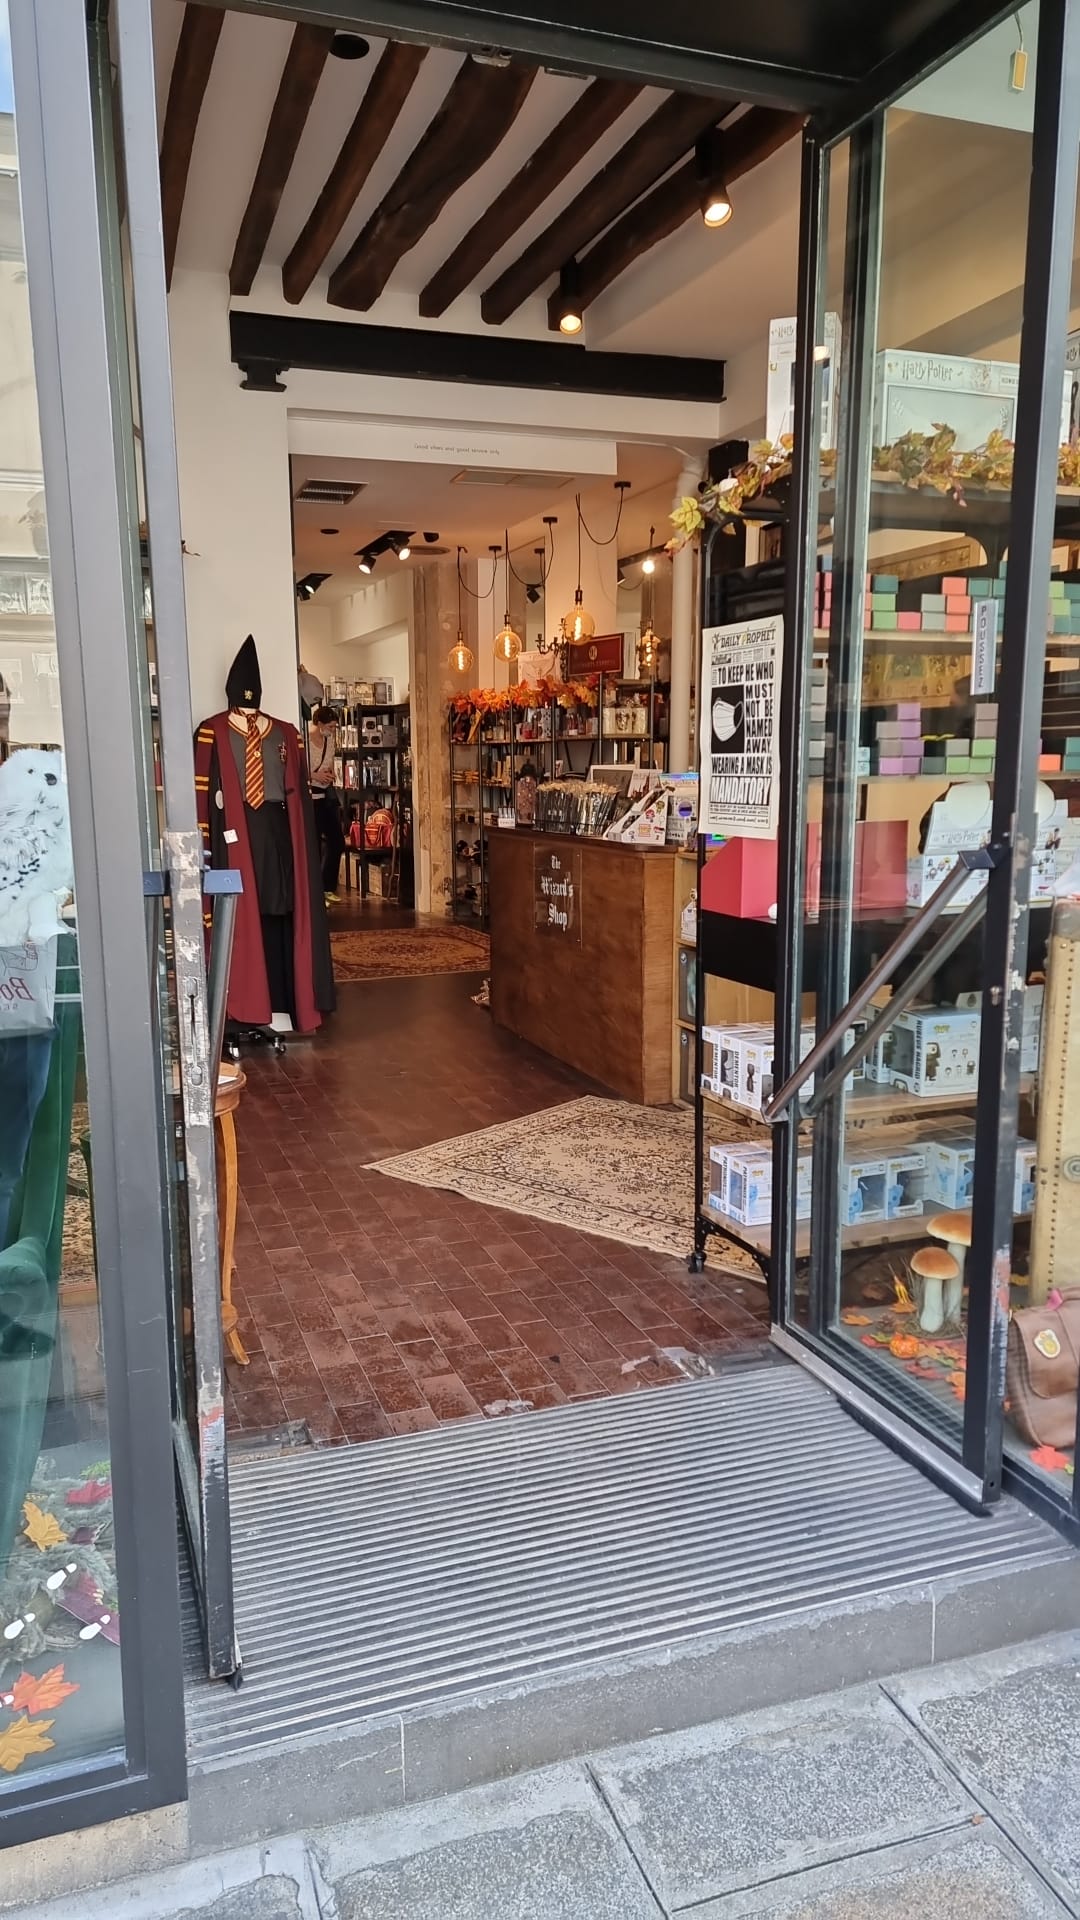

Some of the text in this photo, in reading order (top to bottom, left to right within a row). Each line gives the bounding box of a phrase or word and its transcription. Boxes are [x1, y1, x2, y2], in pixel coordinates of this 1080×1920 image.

[902, 359, 954, 382] Harry Potter
[721, 628, 776, 648] DAILY PROPHET
[978, 605, 987, 688] POUSSEZ
[718, 667, 727, 685] TO
[728, 665, 744, 683] KEEP
[745, 663, 754, 681] HE
[755, 660, 774, 680] WHO
[745, 683, 774, 699] MUST
[745, 699, 773, 718] NOT BE
[745, 718, 773, 738] NAMED
[711, 756, 773, 775] WEARING A MASK IS
[711, 777, 771, 805] MANDATORY
[551, 854, 561, 870] The
[541, 875, 574, 897] Wizard's
[547, 903, 568, 931] Shop
